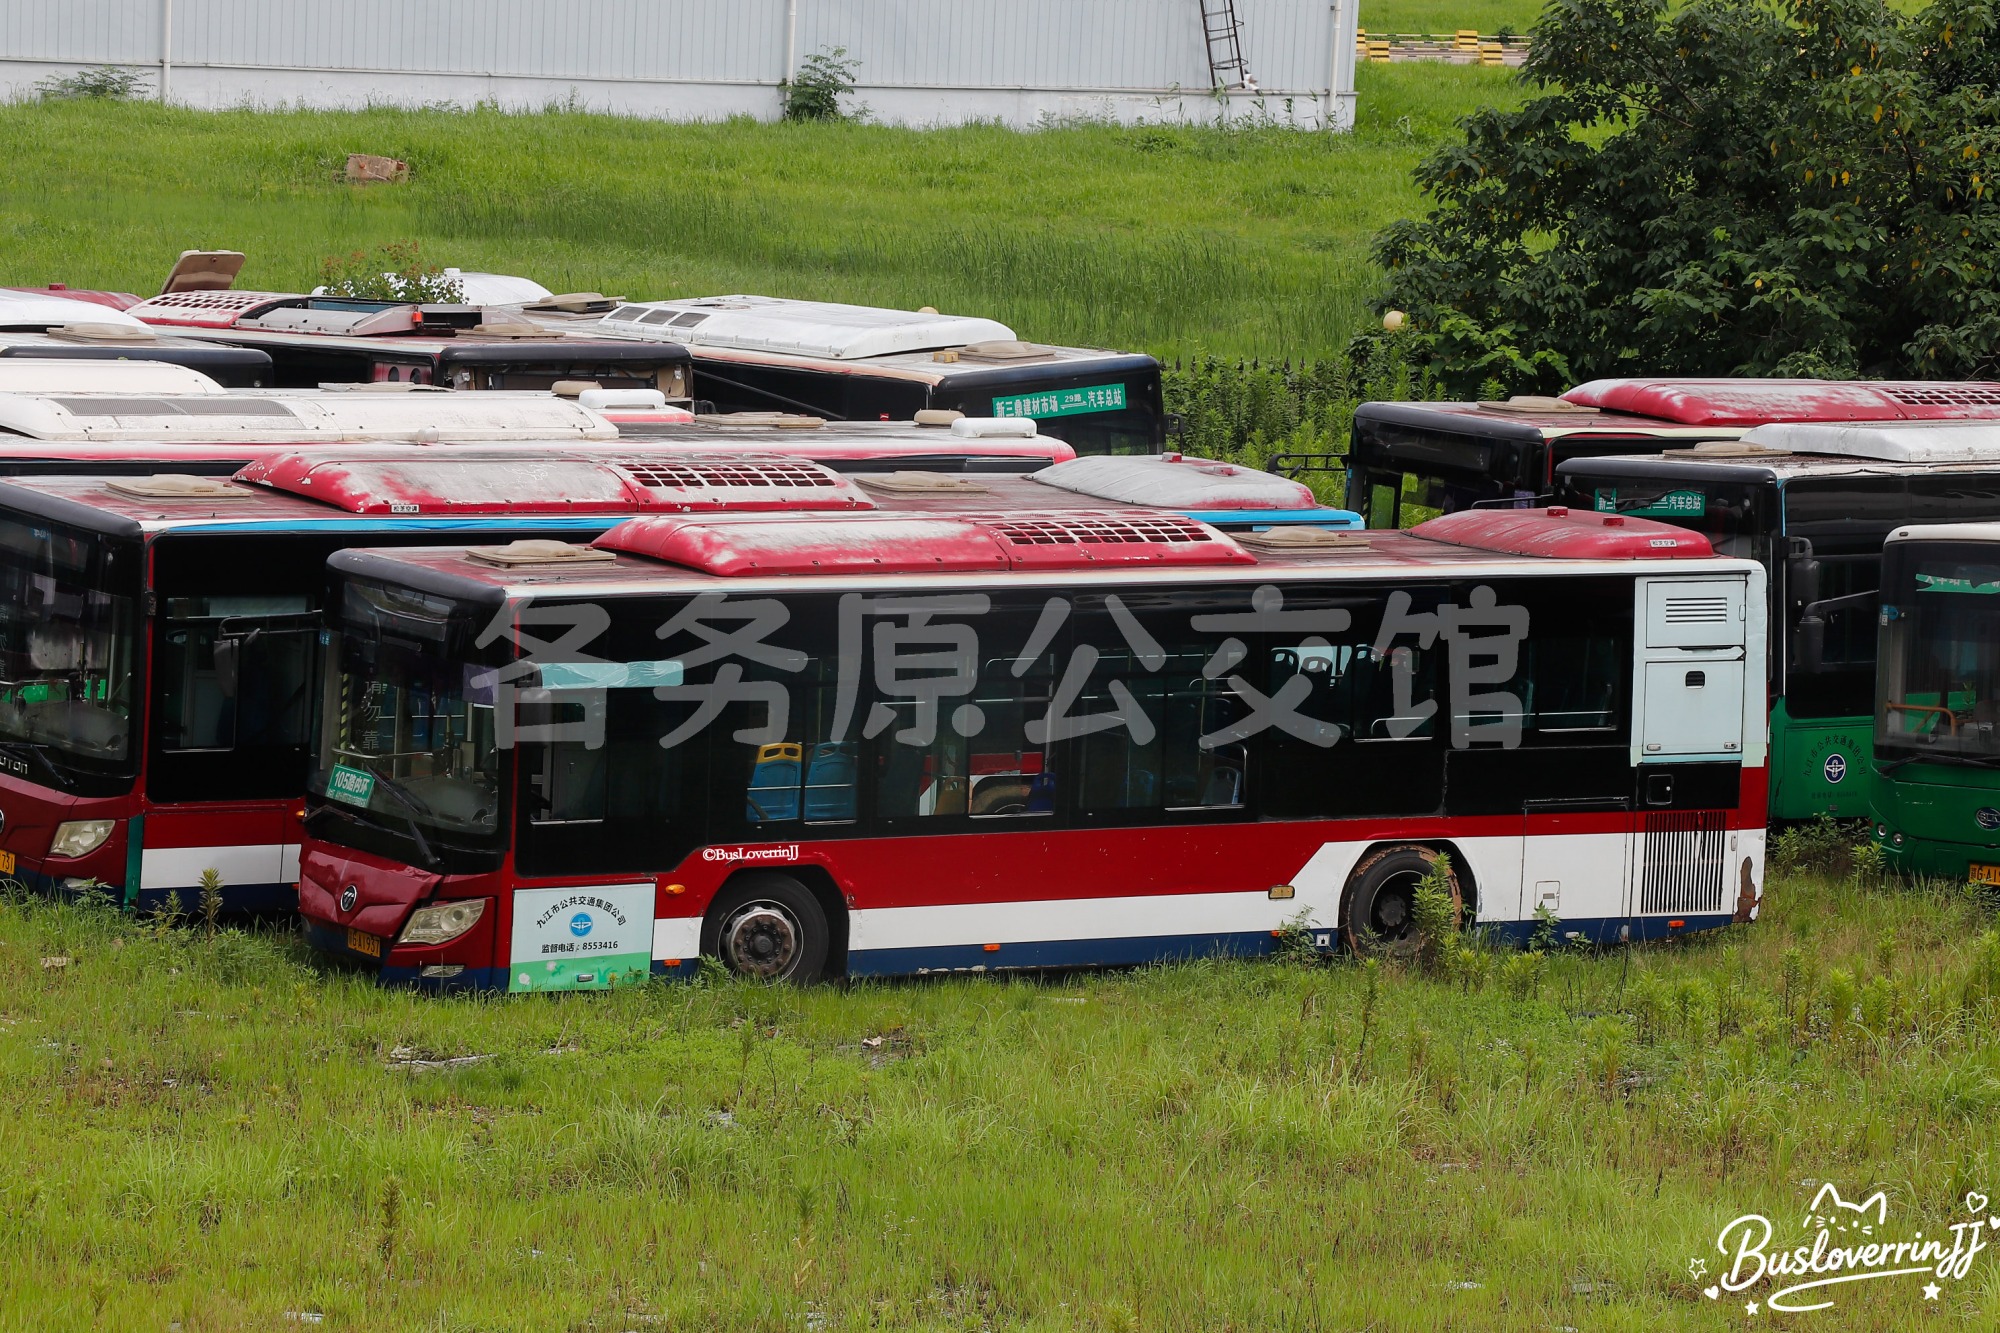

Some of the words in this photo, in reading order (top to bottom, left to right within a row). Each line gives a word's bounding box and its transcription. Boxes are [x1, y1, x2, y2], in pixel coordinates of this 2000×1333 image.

[996, 395, 1059, 418] 新三鼎建材市场
[1087, 388, 1122, 408] 汽车总站
[1668, 495, 1701, 511] 汽车总站
[535, 895, 628, 929] 九江市公共交通集团公司
